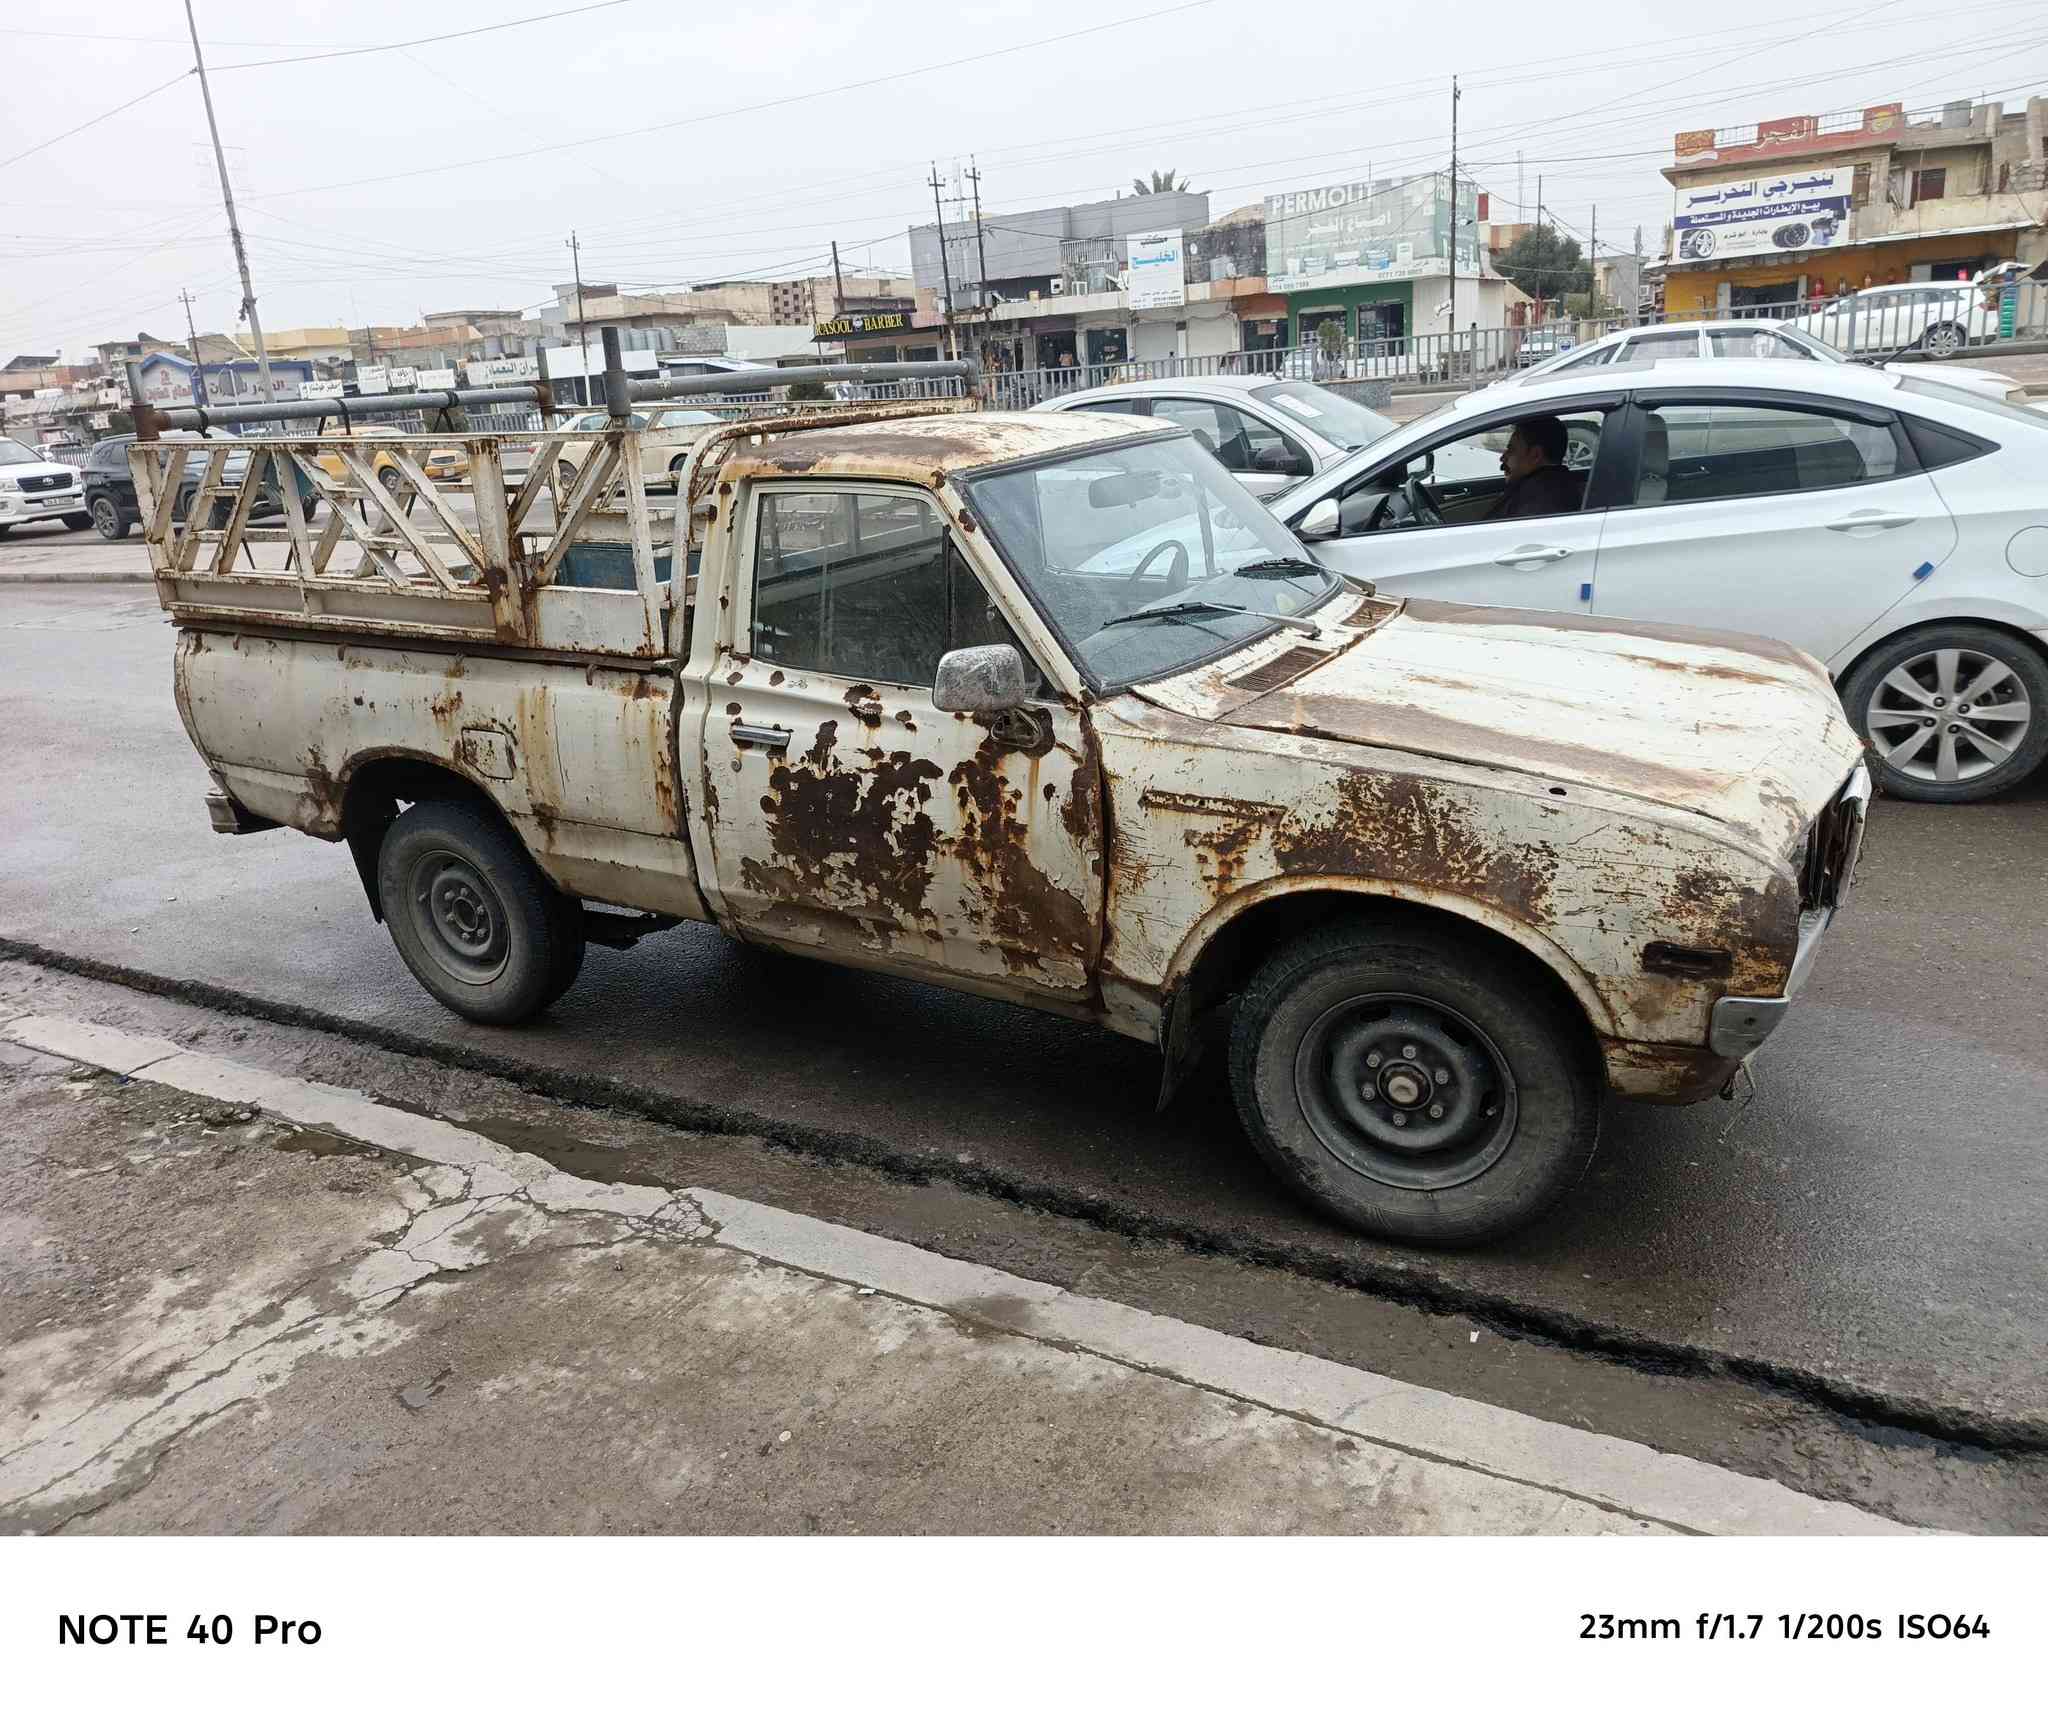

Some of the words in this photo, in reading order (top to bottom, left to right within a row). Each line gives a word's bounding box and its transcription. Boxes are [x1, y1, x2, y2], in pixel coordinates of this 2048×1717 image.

[1271, 182, 1376, 215] PERMOLIT
[1801, 201, 1821, 213] بيع
[1131, 249, 1178, 270] الخليج
[815, 319, 853, 336] RASOOL
[864, 313, 904, 332] BARBER
